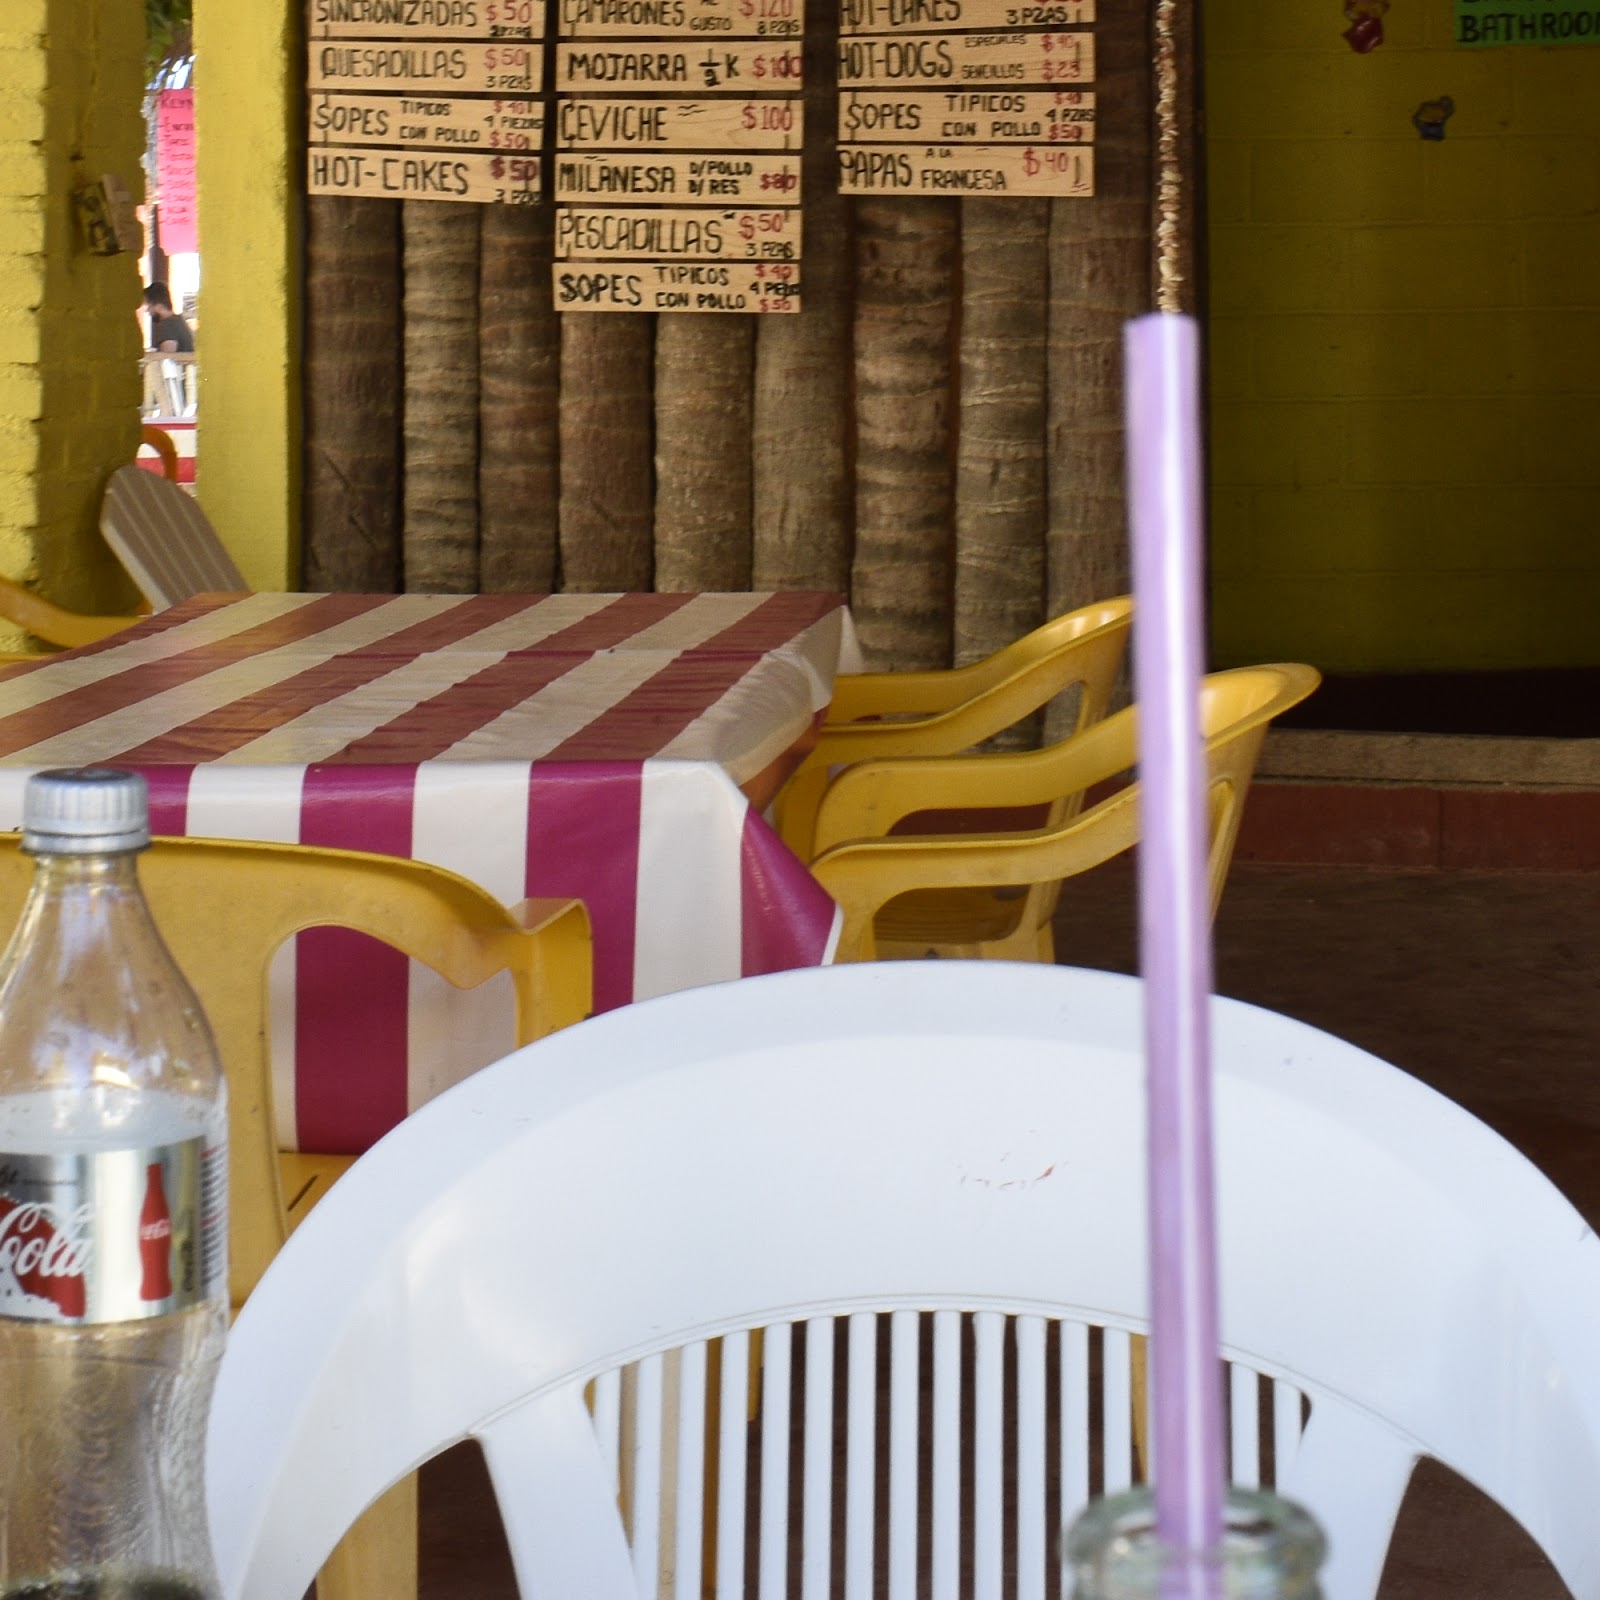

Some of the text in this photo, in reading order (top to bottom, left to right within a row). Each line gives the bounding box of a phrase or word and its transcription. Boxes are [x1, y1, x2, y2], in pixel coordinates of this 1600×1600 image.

[484, 0, 533, 25] $50
[689, 16, 733, 31] GUSTO
[1006, 7, 1068, 24] 3 PZAS
[319, 46, 527, 80] QUESADILLAS $50
[566, 52, 687, 82] MOJARRA
[839, 39, 954, 80] HOT-DOGS
[844, 103, 922, 131] SOPES
[944, 94, 1026, 113] TIPICOS
[313, 103, 390, 136] SOPES
[560, 102, 669, 142] CEVICHE
[991, 121, 1042, 139] POLLO
[434, 127, 480, 143] POLLO
[313, 155, 469, 196] HOT-CAKES
[558, 162, 676, 195] MILANESA
[839, 149, 914, 190] PAPAS
[1022, 146, 1070, 178] $40
[920, 167, 1008, 192] FRANCESA
[558, 214, 723, 254] PESCADILLAS
[652, 265, 731, 286] TIPICOS
[559, 273, 642, 308] SOPES
[696, 293, 747, 310] POLLO
